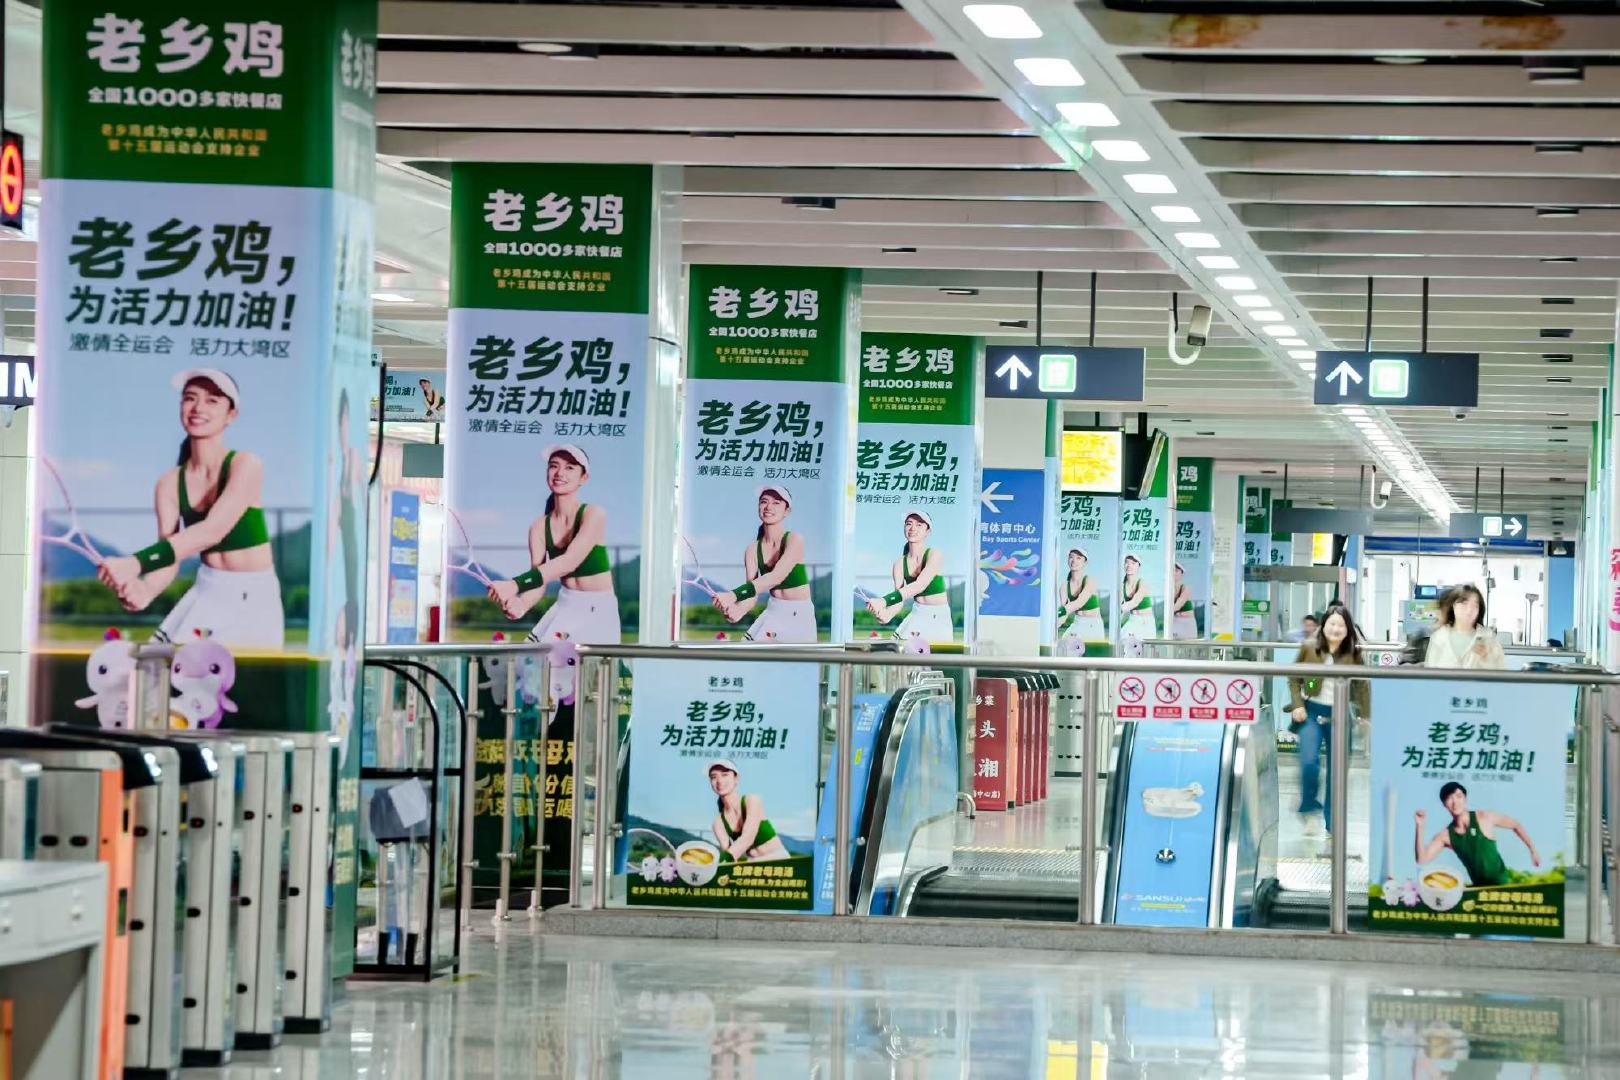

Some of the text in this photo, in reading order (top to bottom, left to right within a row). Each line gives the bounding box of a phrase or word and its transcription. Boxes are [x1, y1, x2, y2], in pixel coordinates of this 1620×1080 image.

[86, 13, 284, 77] 老乡鸡
[88, 86, 283, 110] 全国1000多家快餐店
[101, 123, 268, 142] 老乡鸡成为中华人民共和国
[483, 188, 624, 235] 老乡鸡
[68, 217, 295, 286] 老乡鸡，
[484, 241, 623, 258] 全国1000多家快餐店
[66, 286, 296, 331] 为活力加油！
[708, 285, 819, 321] 老乡鸡
[708, 326, 817, 339] 全国1000多家快餐店
[69, 333, 290, 359] 激情全运会 活力大湾区
[468, 335, 630, 385] 老乡鸡，
[863, 345, 954, 375] 老乡鸡
[863, 379, 953, 390] 全国1000多家快餐店
[465, 383, 631, 419] 为活力加油！
[468, 419, 625, 437] 激情全运会 活力大湾区
[697, 400, 823, 438] 老乡鸡，
[695, 438, 824, 464] 为活力加油！
[857, 440, 958, 472] 老乡鸡，
[697, 465, 821, 479] 激情全运会 活力大湾区
[908, 494, 956, 506] 活力大湾区
[708, 676, 744, 687] 老乡鸡
[686, 700, 764, 724] 老乡鸡，
[1450, 696, 1488, 709] 老乡鸡
[660, 724, 788, 750] 为活力加油！
[1427, 721, 1510, 746] 老乡鸡，
[1401, 746, 1535, 773] 为活力加油！
